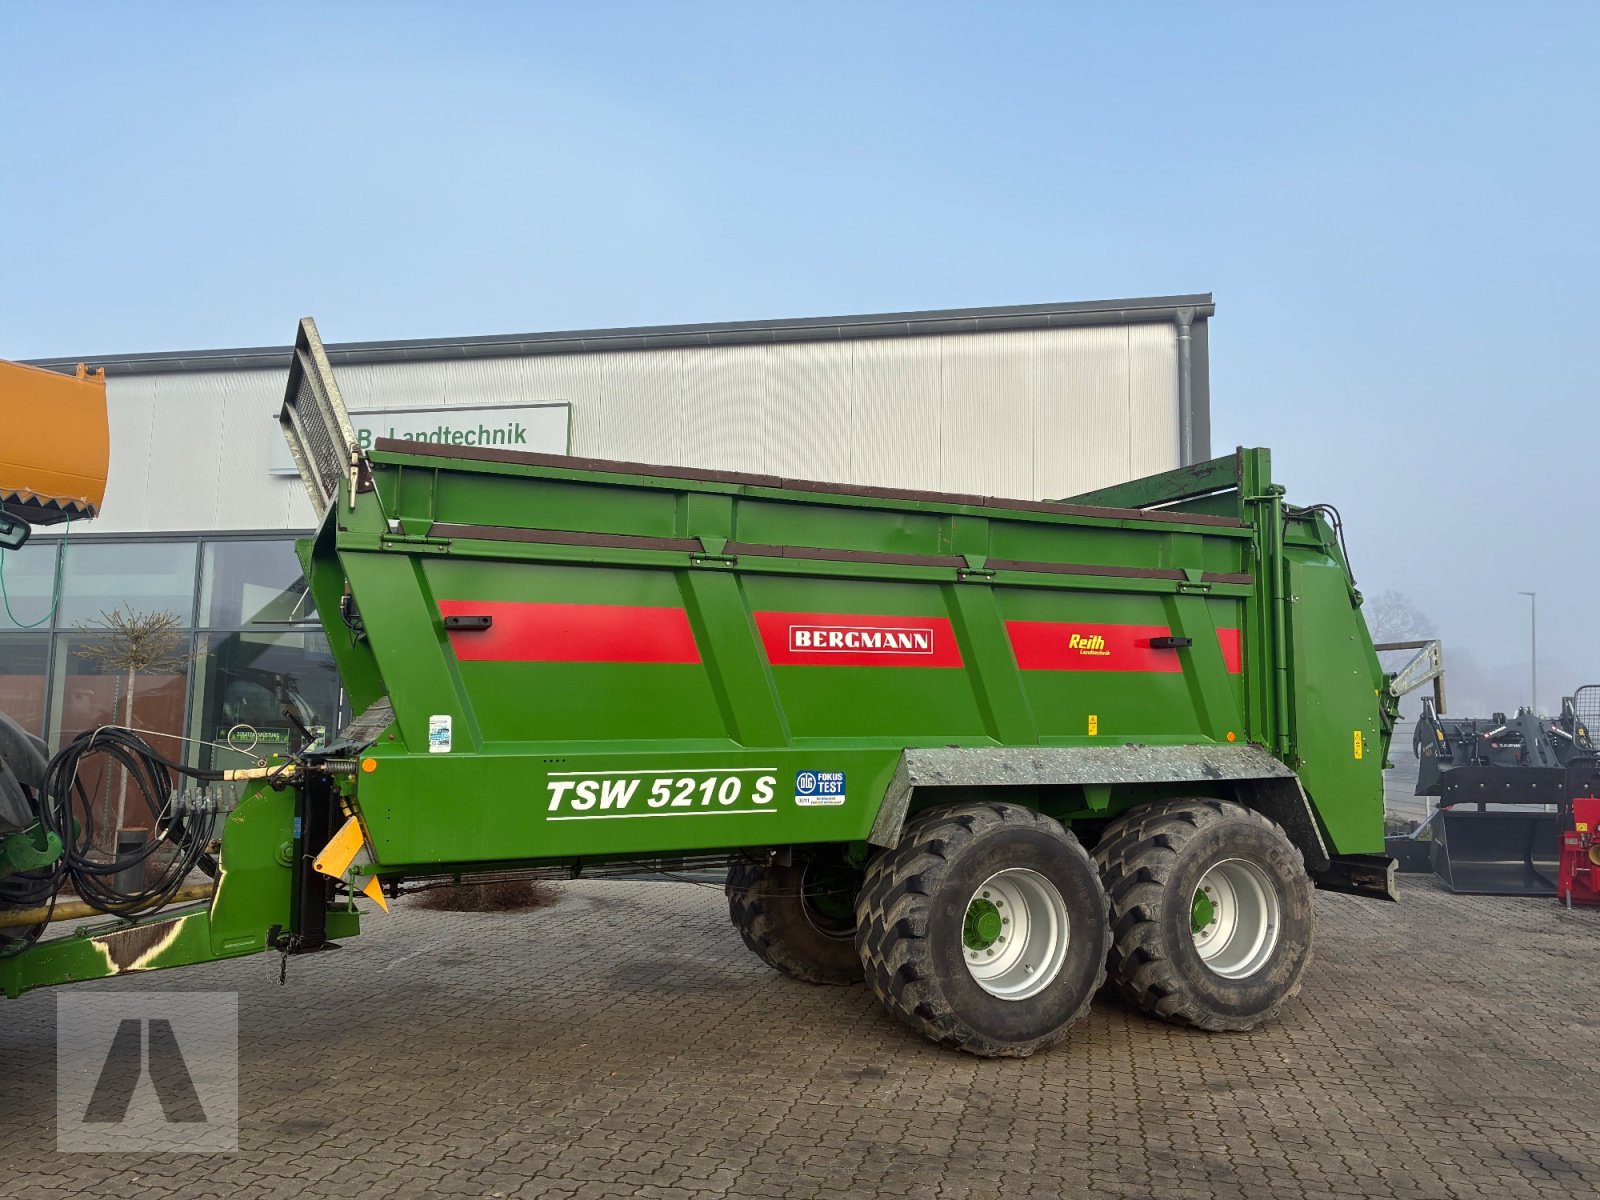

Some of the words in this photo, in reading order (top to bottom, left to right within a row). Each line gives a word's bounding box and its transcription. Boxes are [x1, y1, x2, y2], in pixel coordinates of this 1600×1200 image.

[795, 630, 928, 649] BERGMANN
[1068, 633, 1105, 650] Reith
[817, 772, 843, 781] FOKUS
[546, 779, 641, 811] TSW
[647, 776, 742, 808] 5210
[751, 775, 777, 804] S
[817, 781, 843, 793] TEST
